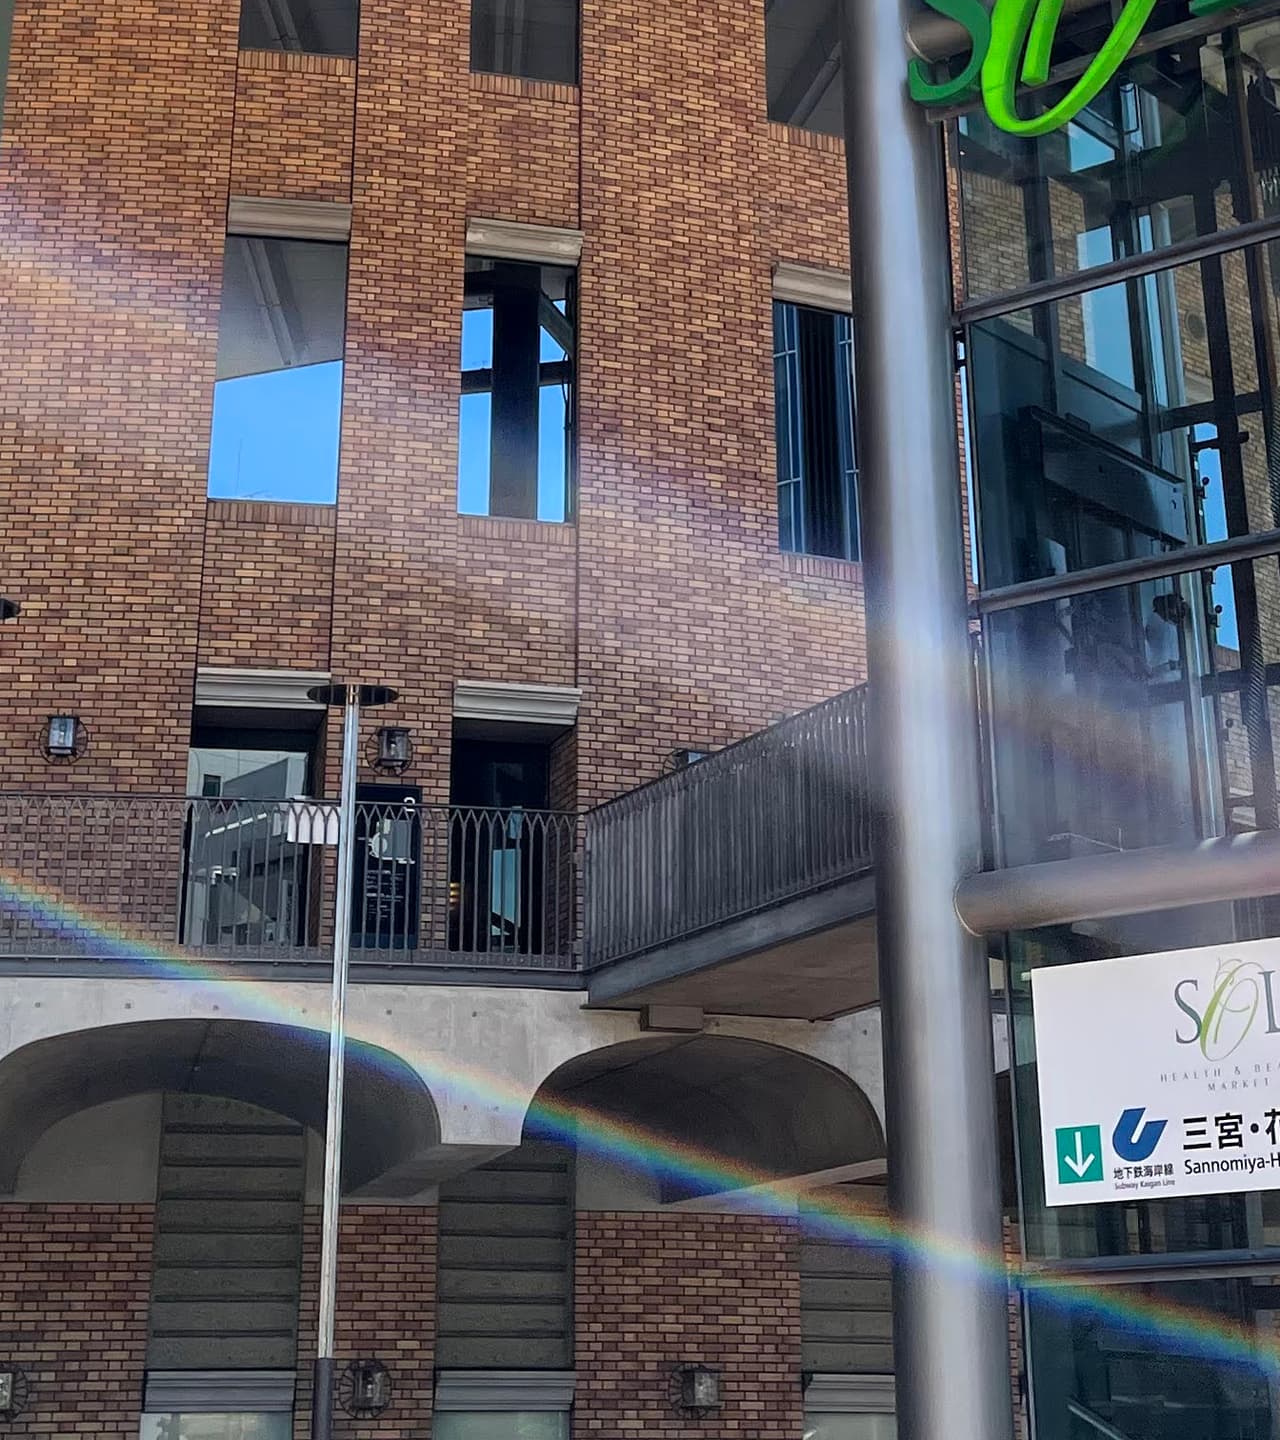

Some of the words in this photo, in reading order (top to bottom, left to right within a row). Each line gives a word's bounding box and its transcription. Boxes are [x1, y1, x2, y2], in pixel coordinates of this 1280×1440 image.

[1160, 1068, 1221, 1083] HEALTH
[1234, 1065, 1241, 1075] &
[1207, 1077, 1270, 1091] MARKET
[1113, 1163, 1174, 1180] 地下鉄海岸線
